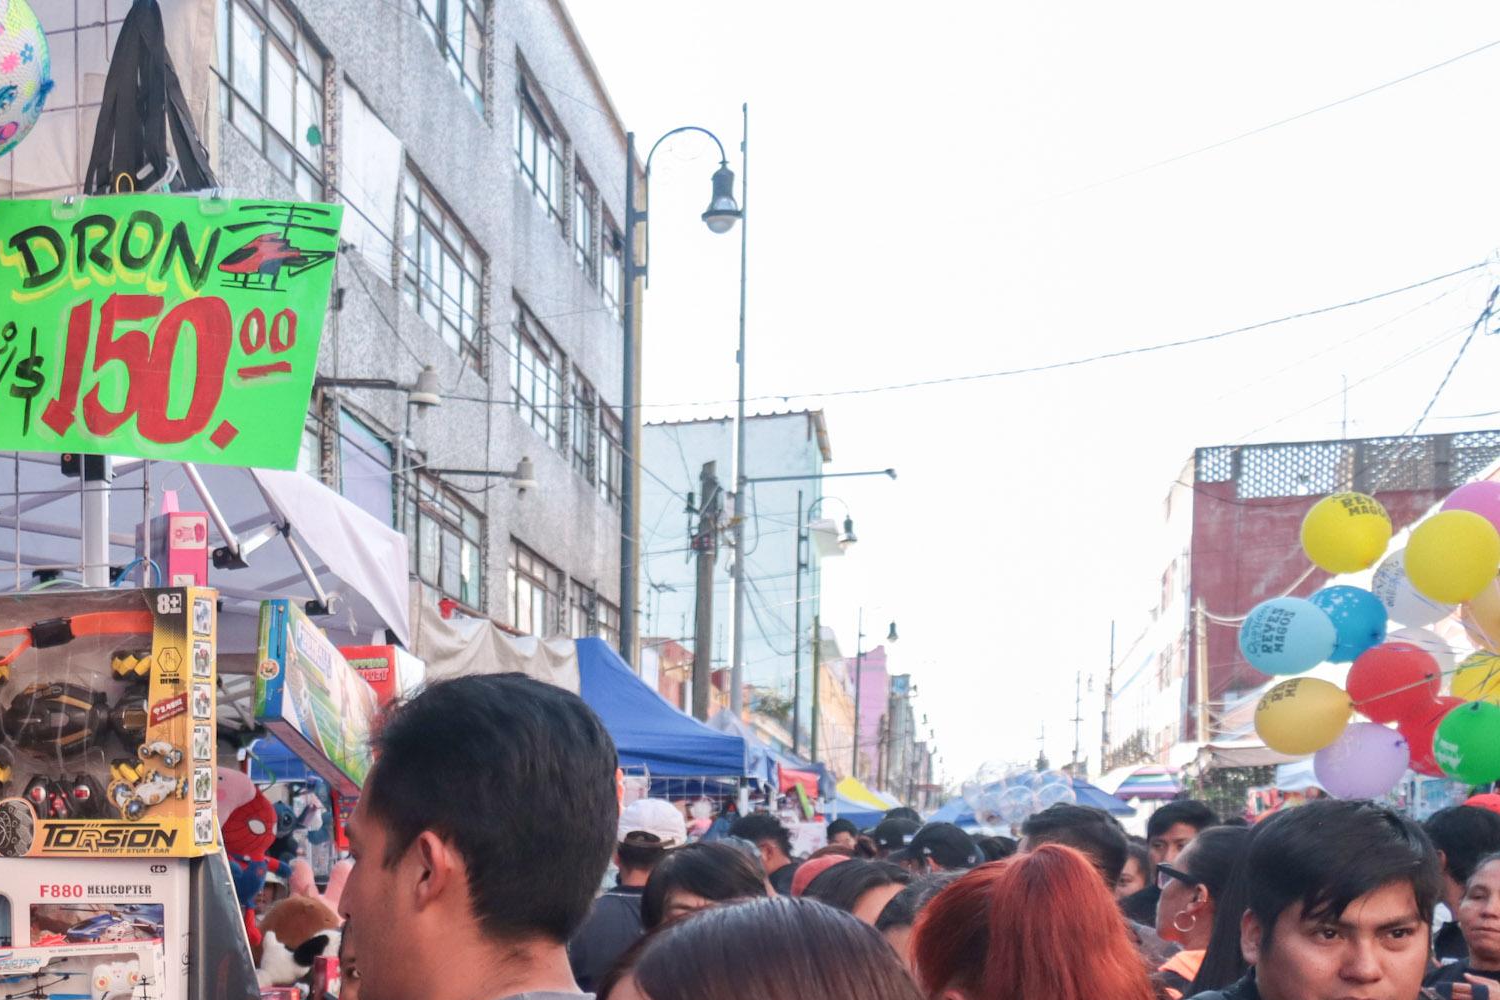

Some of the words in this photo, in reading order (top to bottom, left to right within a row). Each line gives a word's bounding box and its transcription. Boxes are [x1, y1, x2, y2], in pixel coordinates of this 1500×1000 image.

[8, 210, 222, 292] DRON
[1262, 607, 1286, 654] REYES
[1274, 610, 1297, 653] MAGOS
[40, 884, 83, 898] F880
[87, 885, 152, 895] HELICOPTER
